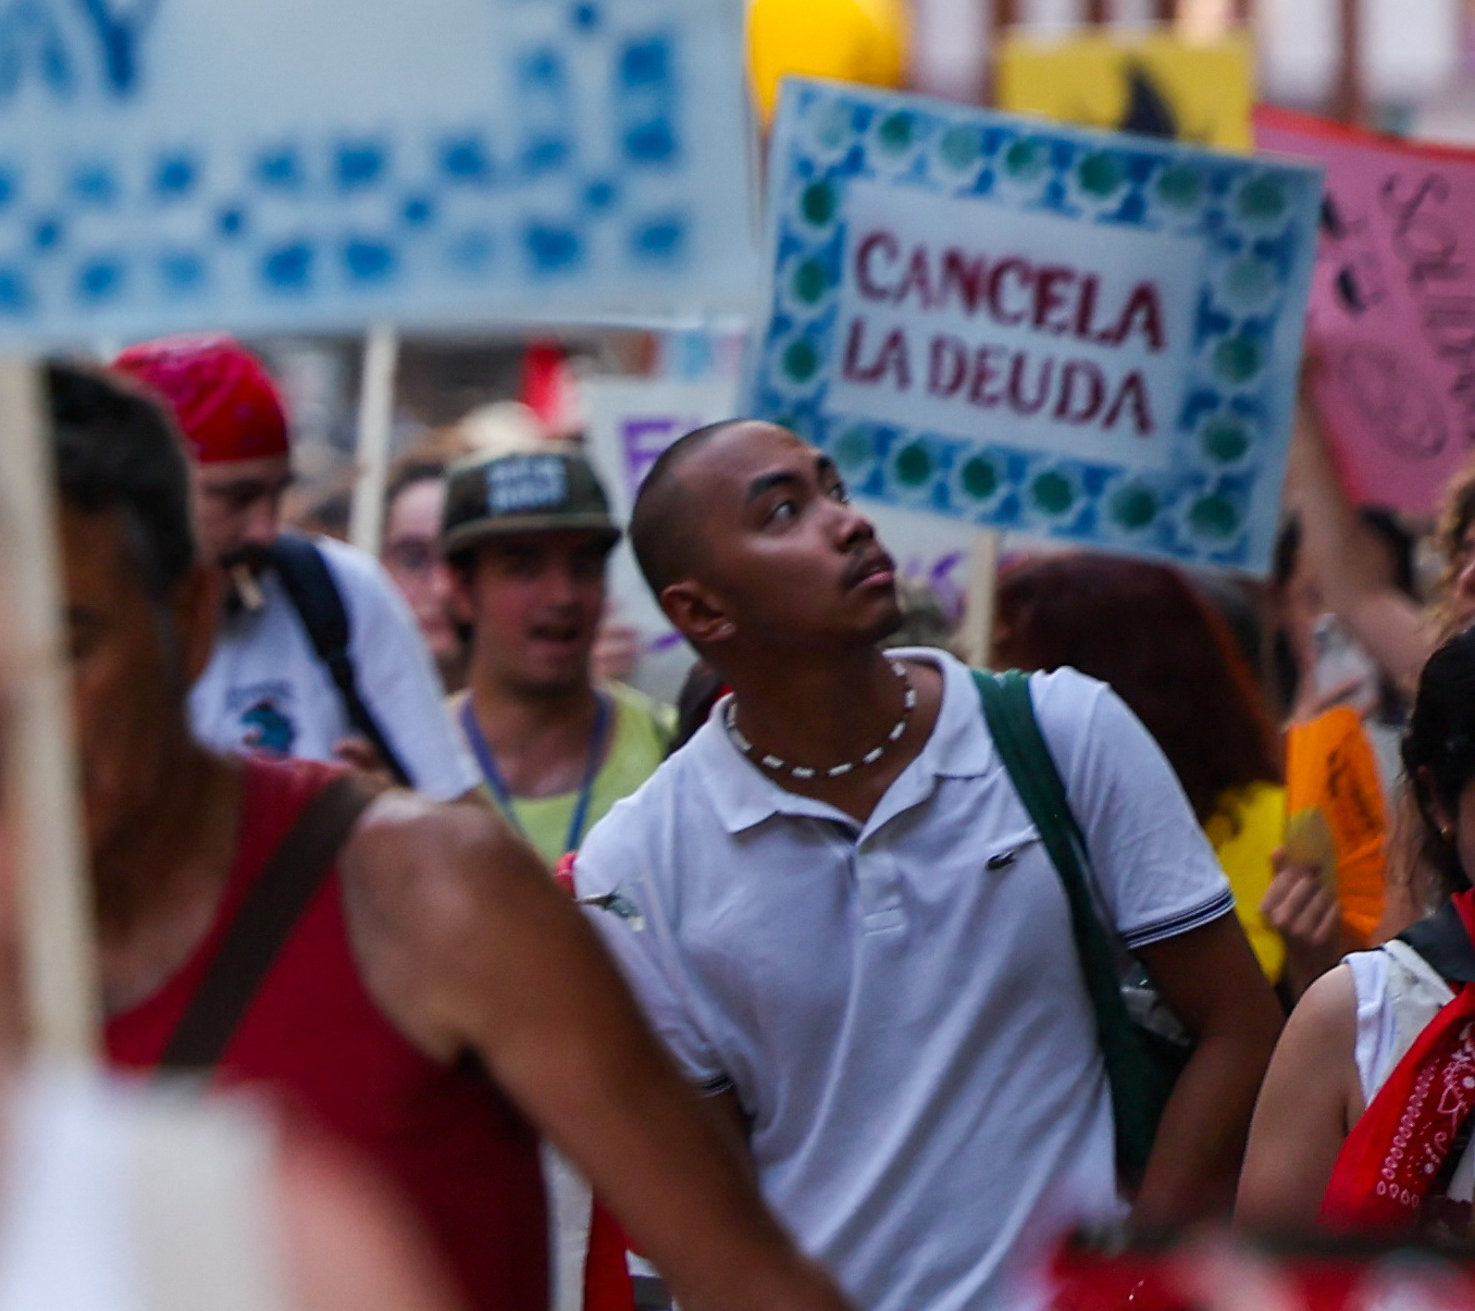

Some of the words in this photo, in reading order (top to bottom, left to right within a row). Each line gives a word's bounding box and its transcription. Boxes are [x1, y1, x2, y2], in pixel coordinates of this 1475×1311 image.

[854, 231, 1169, 354] CANCELA
[842, 318, 912, 394] LA
[927, 335, 1157, 438] DEUDA
